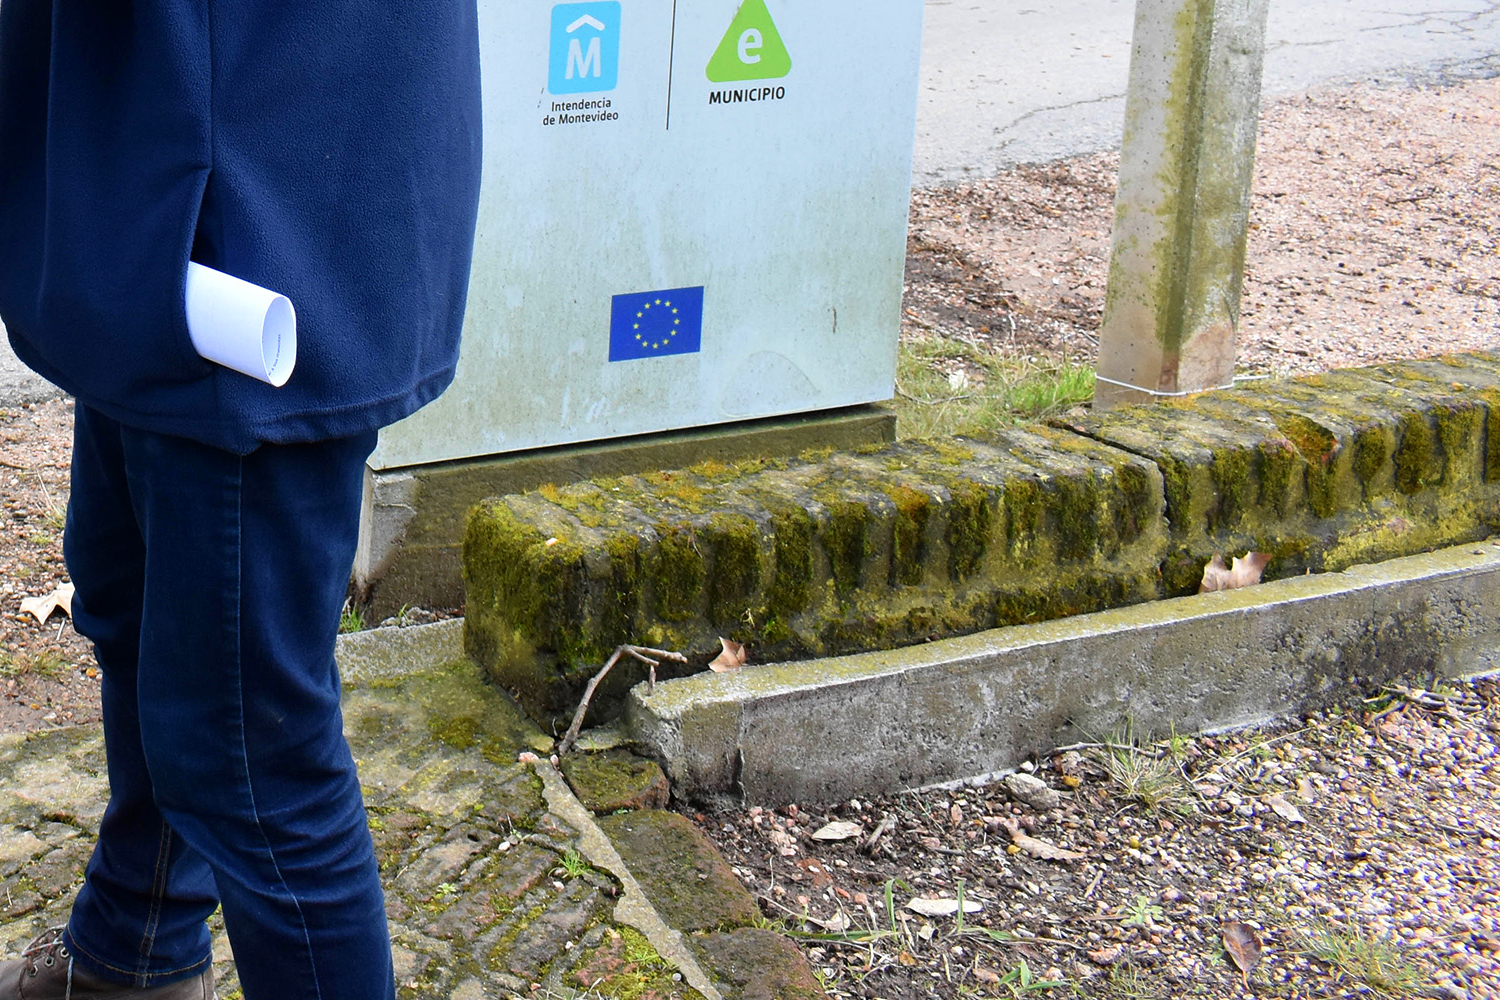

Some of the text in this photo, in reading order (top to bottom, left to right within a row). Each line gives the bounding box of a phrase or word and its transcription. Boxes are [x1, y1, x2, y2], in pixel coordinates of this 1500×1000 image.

[737, 27, 763, 65] e
[709, 86, 786, 105] MUNICIPIO
[551, 97, 612, 113] Intendencia
[542, 108, 619, 126] de Montevideo
